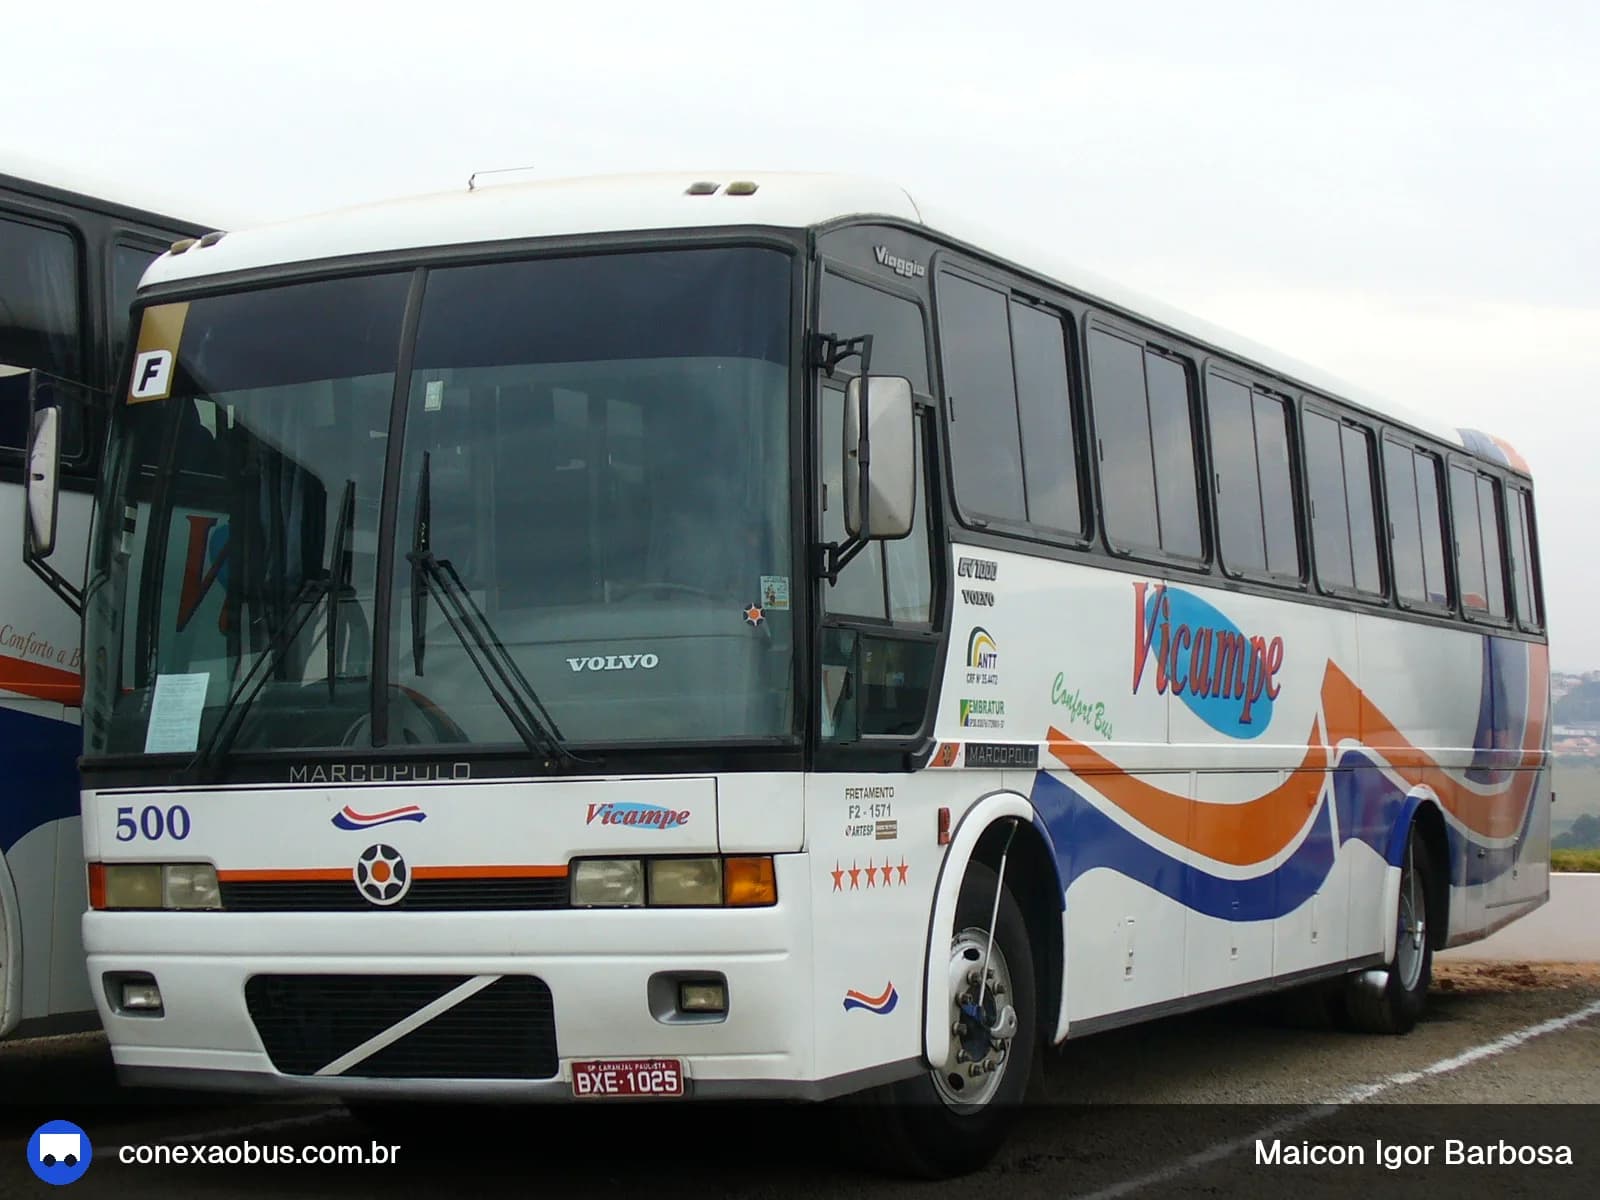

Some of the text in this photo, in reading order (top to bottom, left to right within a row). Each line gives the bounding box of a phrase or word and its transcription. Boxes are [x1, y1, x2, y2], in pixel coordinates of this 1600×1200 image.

[873, 246, 925, 279] Viaggio
[138, 356, 163, 392] F
[961, 589, 995, 607] VOLVO
[0, 624, 54, 659] Conforto
[56, 649, 66, 665] a
[1132, 582, 1284, 724] Vicampe
[567, 653, 660, 672] VOLVO
[977, 653, 998, 669] ANTT
[968, 700, 1005, 715] EMBRATUR
[1051, 672, 1113, 740] Confort Bus
[969, 745, 1036, 764] MARCOPOLO
[289, 762, 471, 783] MARCOPOLO
[845, 787, 894, 800] FRETAMENTO
[586, 803, 691, 829] Vicampe
[848, 805, 860, 819] F2
[869, 803, 891, 818] 1571
[116, 804, 191, 842] 500
[851, 824, 874, 837] ARTESP
